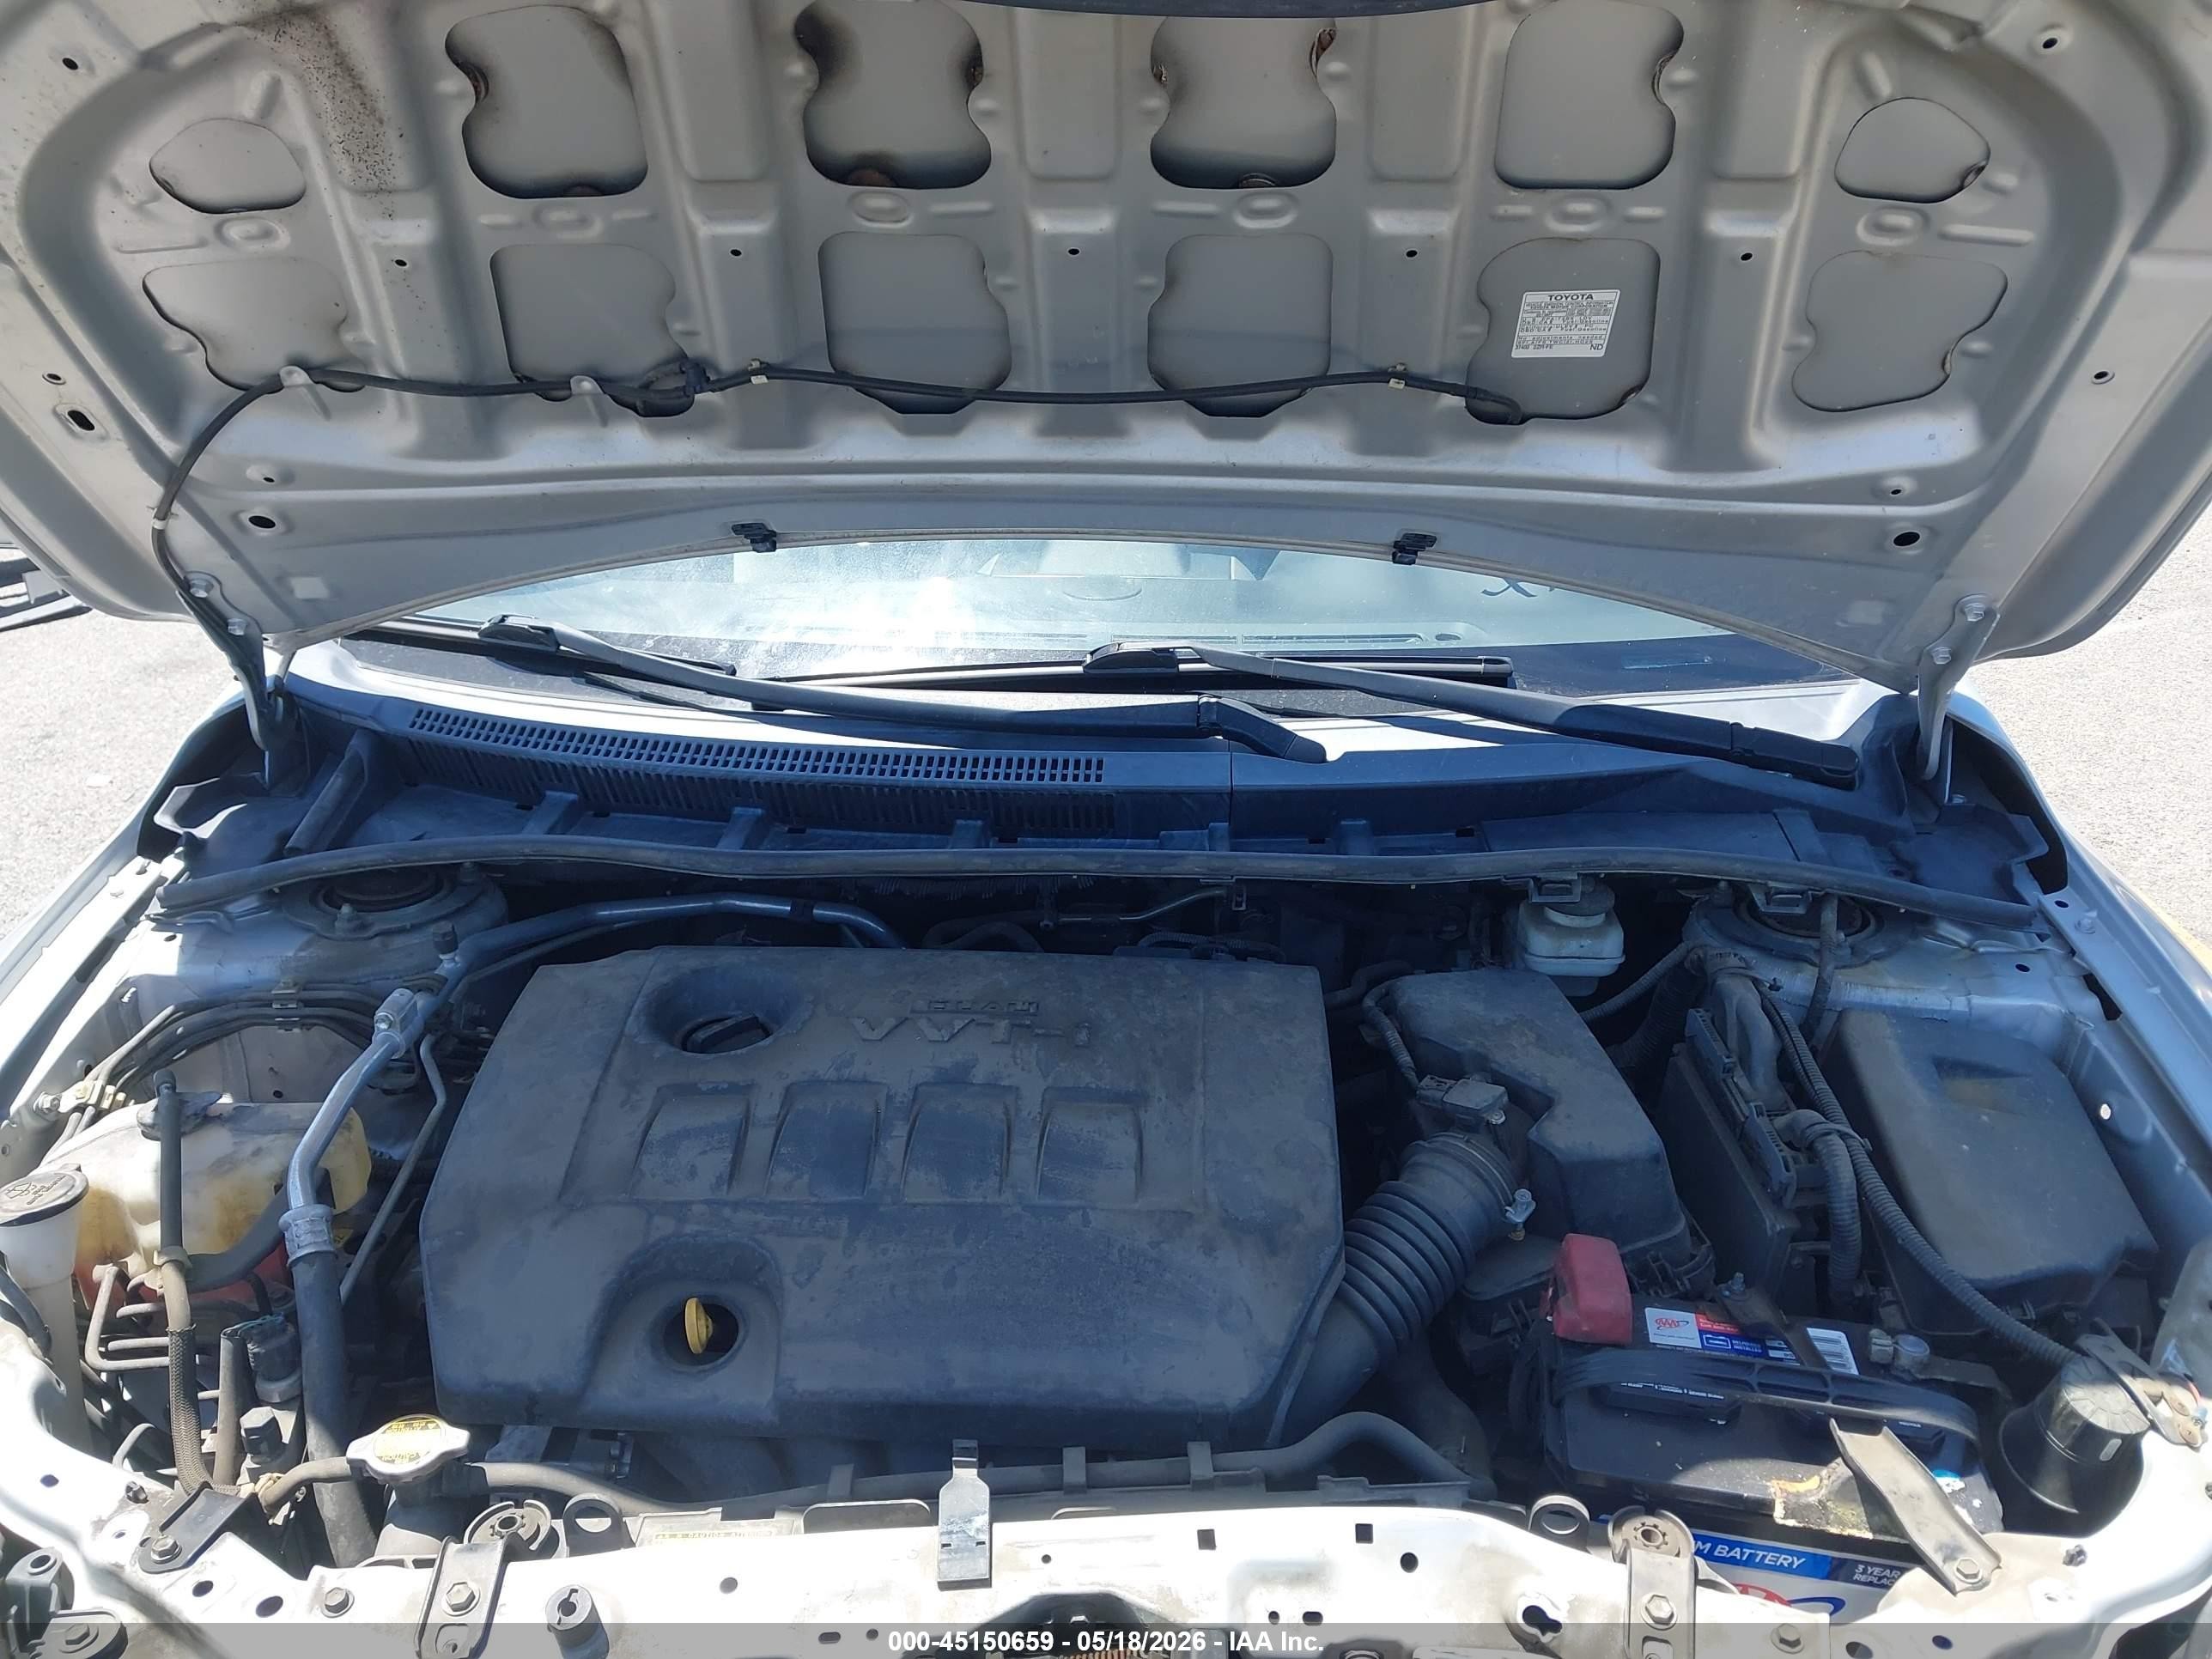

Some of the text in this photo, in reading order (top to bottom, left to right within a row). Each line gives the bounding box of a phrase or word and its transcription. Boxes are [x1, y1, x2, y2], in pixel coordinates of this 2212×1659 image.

[1694, 1540, 1807, 1570] M BATTERY
[1855, 1564, 1901, 1578] 3 YEAR
[1852, 1573, 1896, 1587] REPLAC
